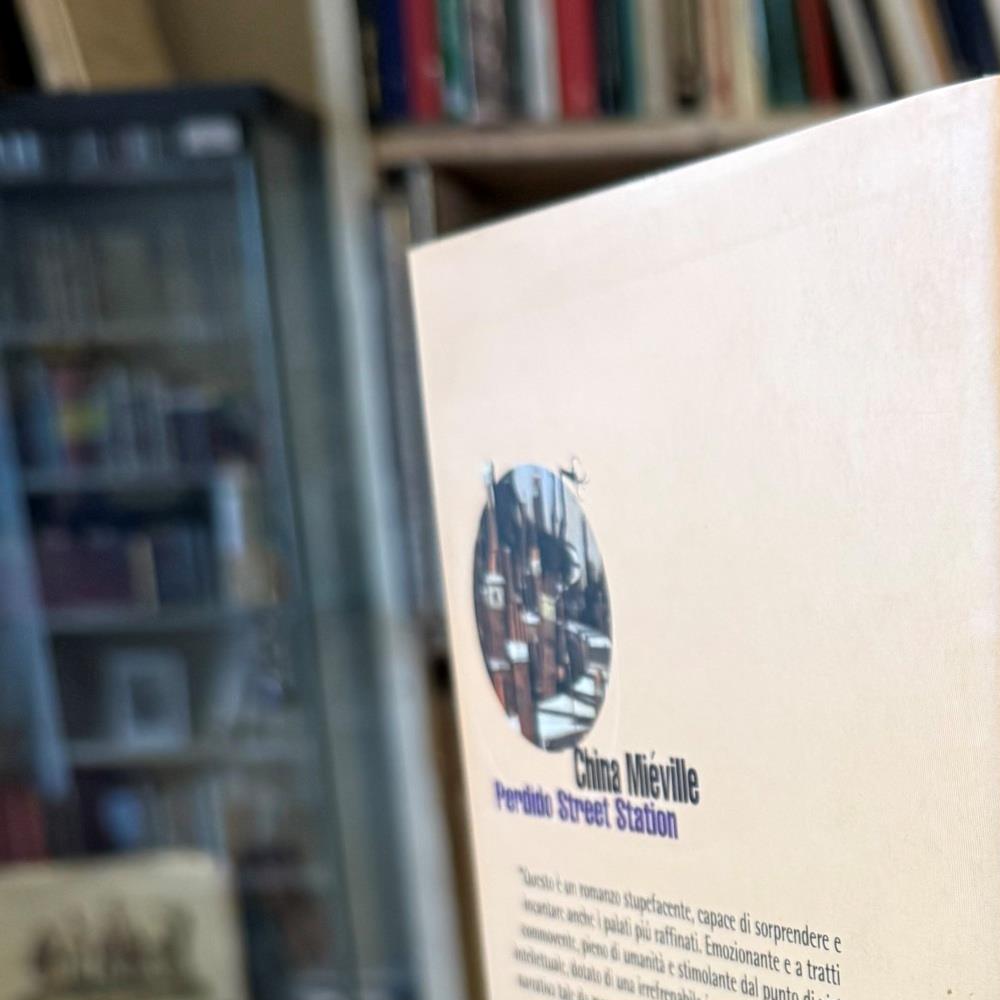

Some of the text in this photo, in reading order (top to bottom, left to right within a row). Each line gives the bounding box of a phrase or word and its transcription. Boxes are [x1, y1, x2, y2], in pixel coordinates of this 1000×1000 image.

[574, 747, 699, 805] China Miéville
[495, 780, 678, 839] Perdido Street Station
[579, 885, 621, 906] romanzo
[624, 891, 695, 924] stupefacente,
[697, 907, 735, 931] capace
[740, 912, 750, 934] di
[755, 920, 829, 951] sorprendere
[834, 936, 842, 953] e
[582, 936, 609, 958] pieno
[611, 942, 620, 961] di
[624, 949, 665, 973] umanità
[669, 961, 675, 976] e
[678, 962, 737, 992] stimolante
[741, 975, 758, 998] dal
[603, 915, 633, 937] palati
[635, 920, 652, 943] più
[655, 924, 702, 953] raffinati.
[705, 935, 779, 972] Emozionante
[784, 958, 791, 974] e
[795, 961, 803, 976] a
[807, 960, 840, 985] tratti
[604, 968, 614, 987] di
[616, 976, 635, 994] una
